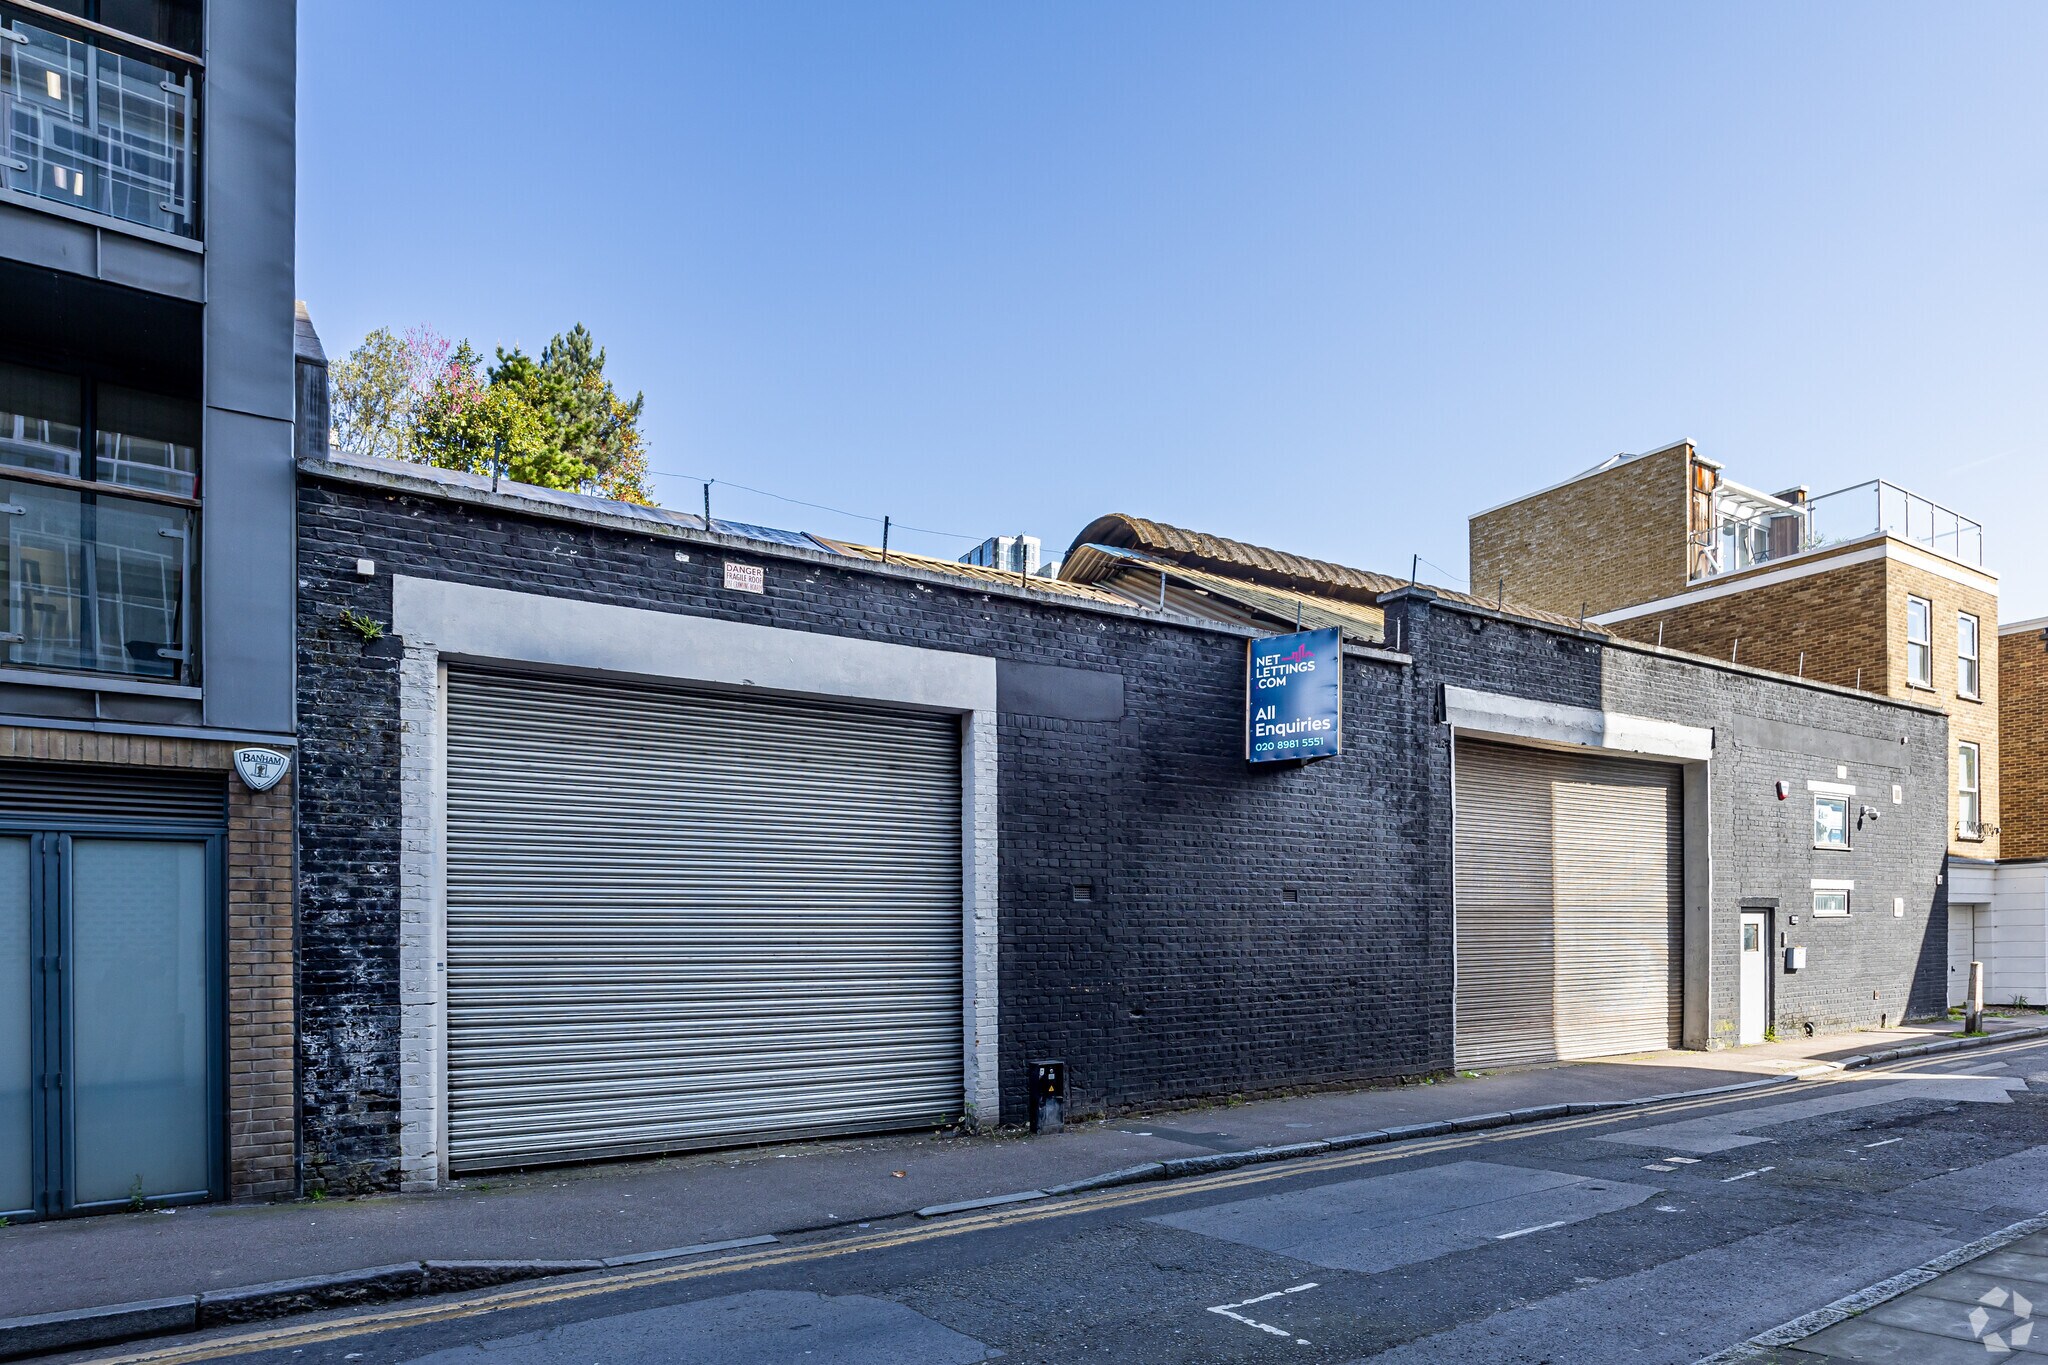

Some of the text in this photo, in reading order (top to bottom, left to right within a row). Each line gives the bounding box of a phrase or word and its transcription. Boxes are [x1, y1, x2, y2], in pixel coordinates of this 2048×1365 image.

[726, 564, 762, 576] DANGER
[726, 572, 762, 584] FRAGILE ROOF
[1256, 654, 1280, 667] NET
[1256, 661, 1315, 678] LETTINGS
[1255, 705, 1275, 721] All
[1255, 717, 1331, 737] Enquiries
[1255, 737, 1324, 751] 020 8981 5551
[242, 753, 281, 765] BANHAM
